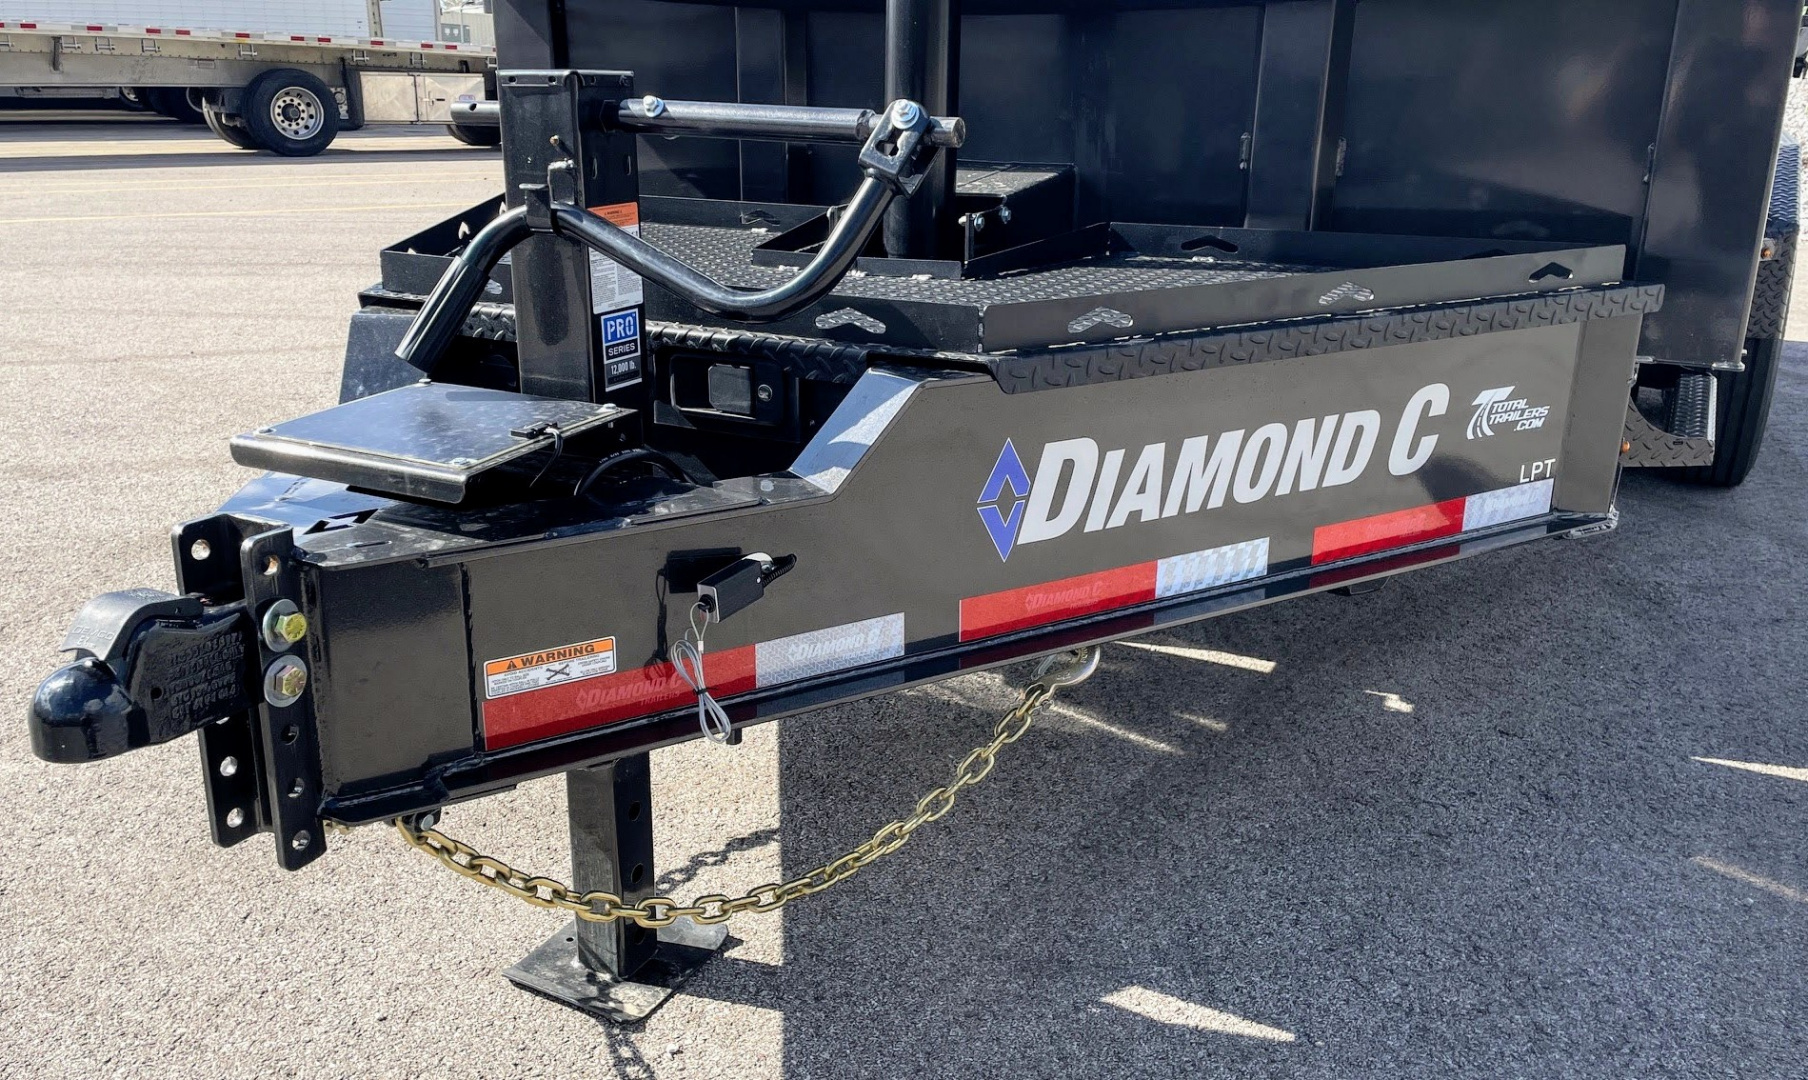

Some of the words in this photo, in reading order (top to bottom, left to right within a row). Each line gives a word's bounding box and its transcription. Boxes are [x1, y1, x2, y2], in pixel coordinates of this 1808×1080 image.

[606, 316, 635, 341] PRO
[608, 342, 636, 356] SERIES
[611, 361, 628, 375] 12,000
[1489, 406, 1551, 425] TRAILERS
[1491, 399, 1530, 414] TOTAL
[1514, 417, 1546, 432] .COM
[1017, 409, 1381, 545] DIAMOND
[1388, 383, 1450, 476] C
[1519, 459, 1557, 484] LPT
[520, 644, 595, 667] WARNING
[796, 634, 866, 660] DIAMOND
[586, 678, 669, 705] DIAMOND
